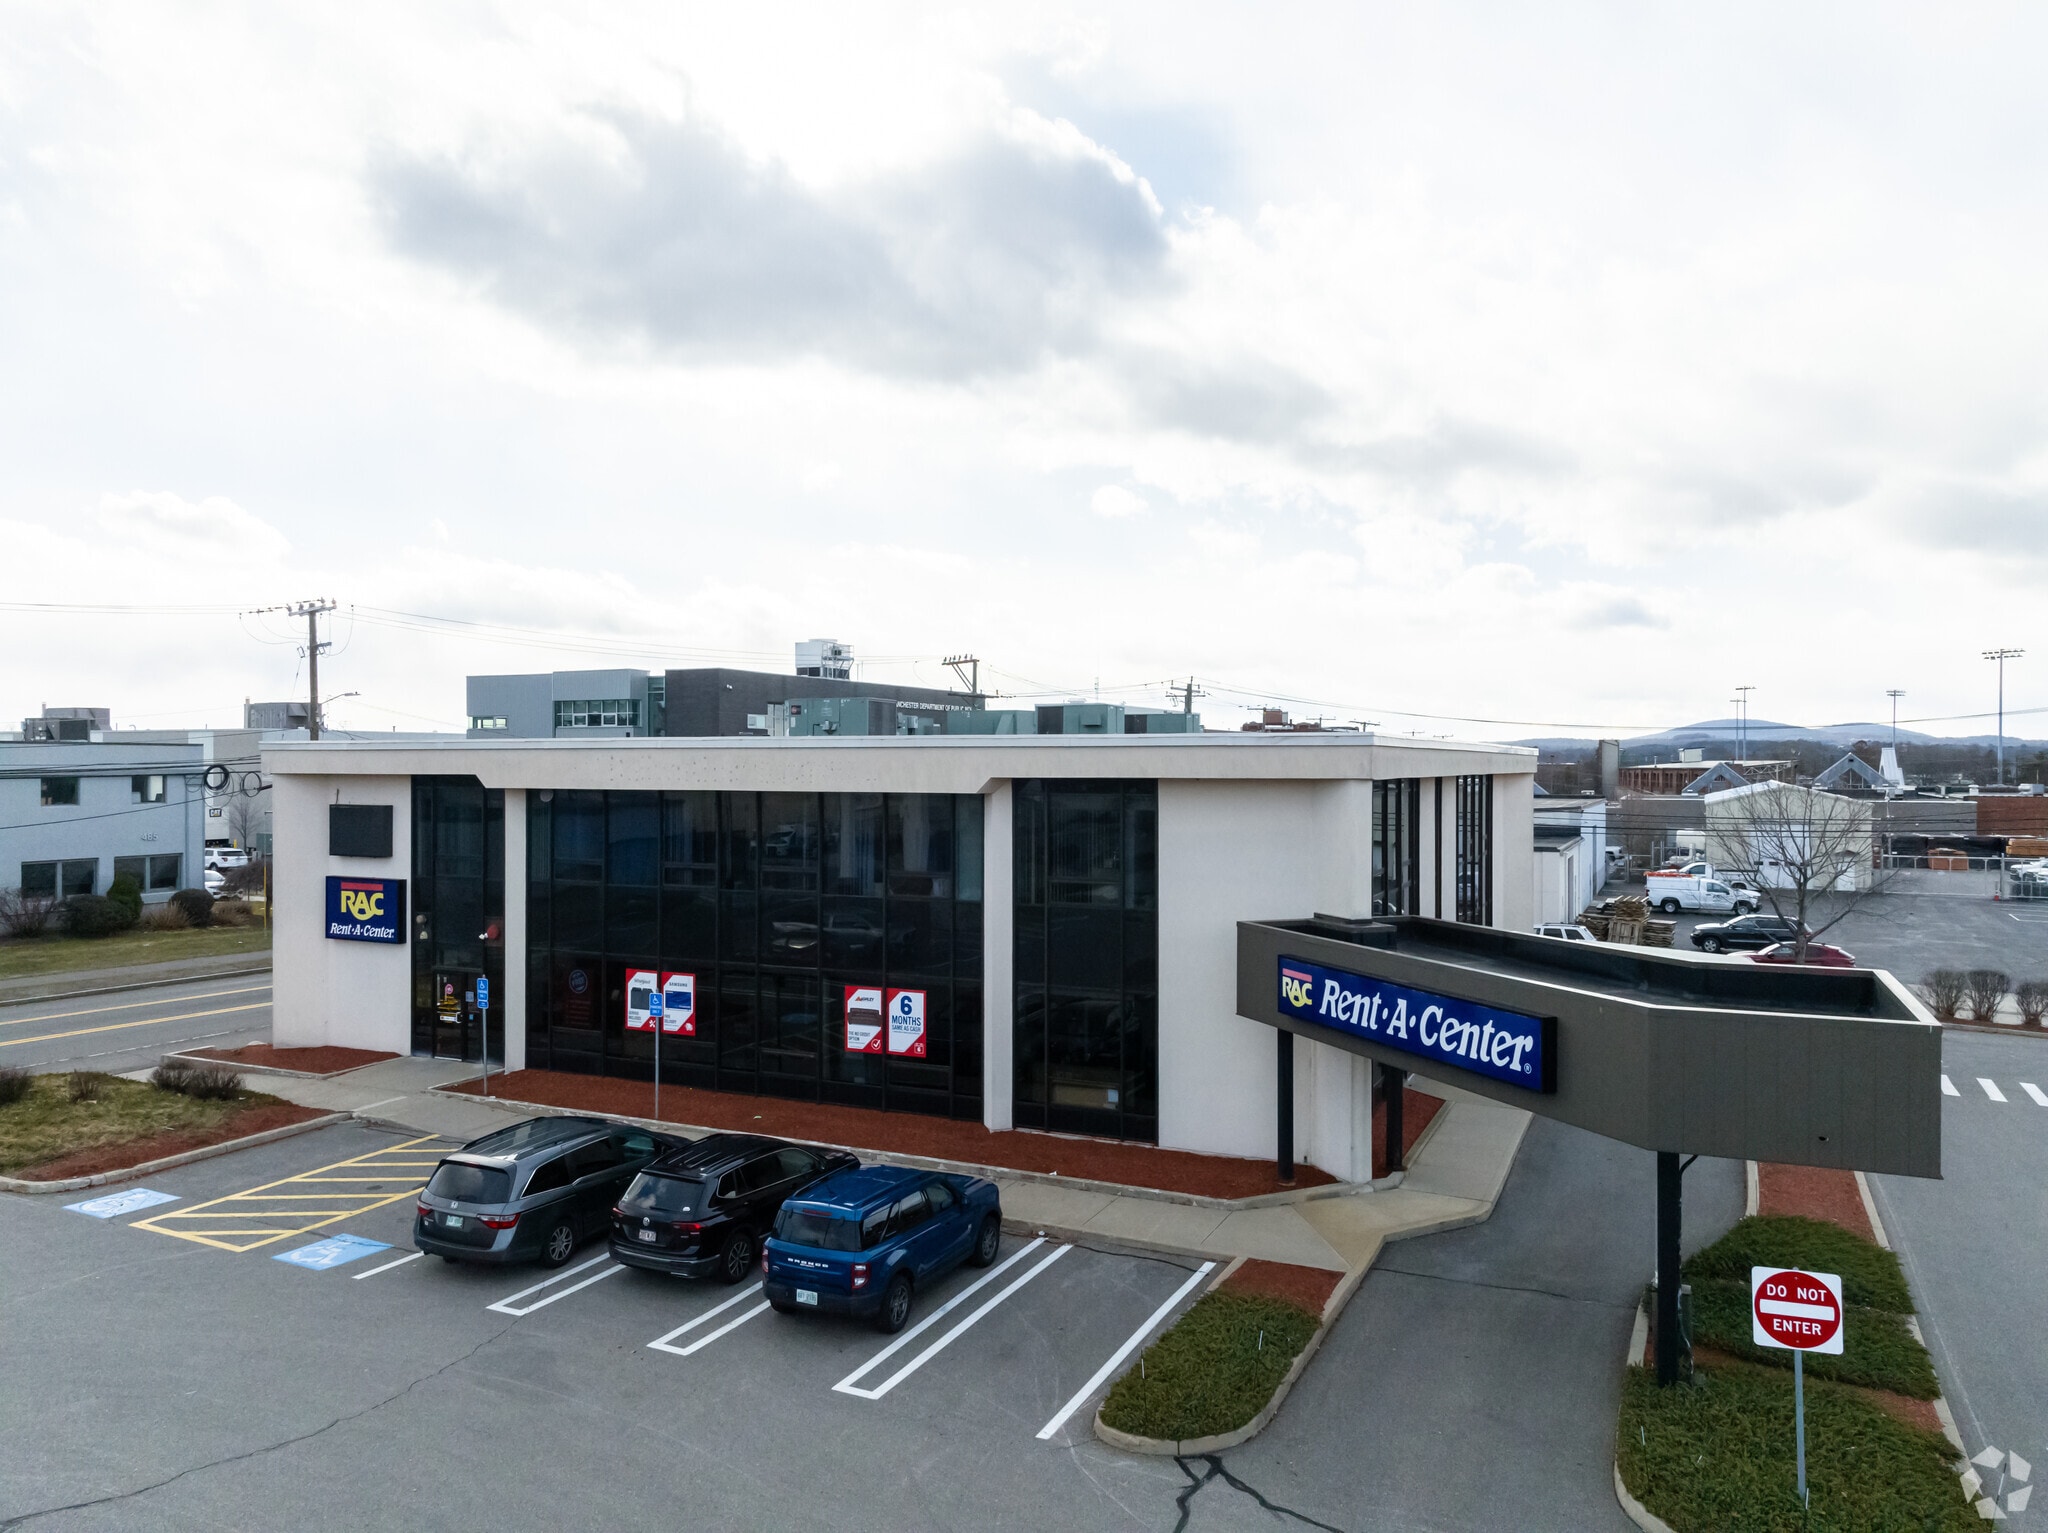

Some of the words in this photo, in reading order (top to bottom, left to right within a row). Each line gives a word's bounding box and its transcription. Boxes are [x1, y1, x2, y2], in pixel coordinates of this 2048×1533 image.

[341, 890, 384, 920] RAC
[1282, 976, 1313, 1008] RAC
[901, 995, 912, 1015] 6
[892, 1015, 921, 1026] MONTHS
[787, 1257, 829, 1268] BRONCO
[1767, 1284, 1787, 1297] DO
[1797, 1287, 1827, 1302] NOT
[1773, 1318, 1822, 1336] ENTER
